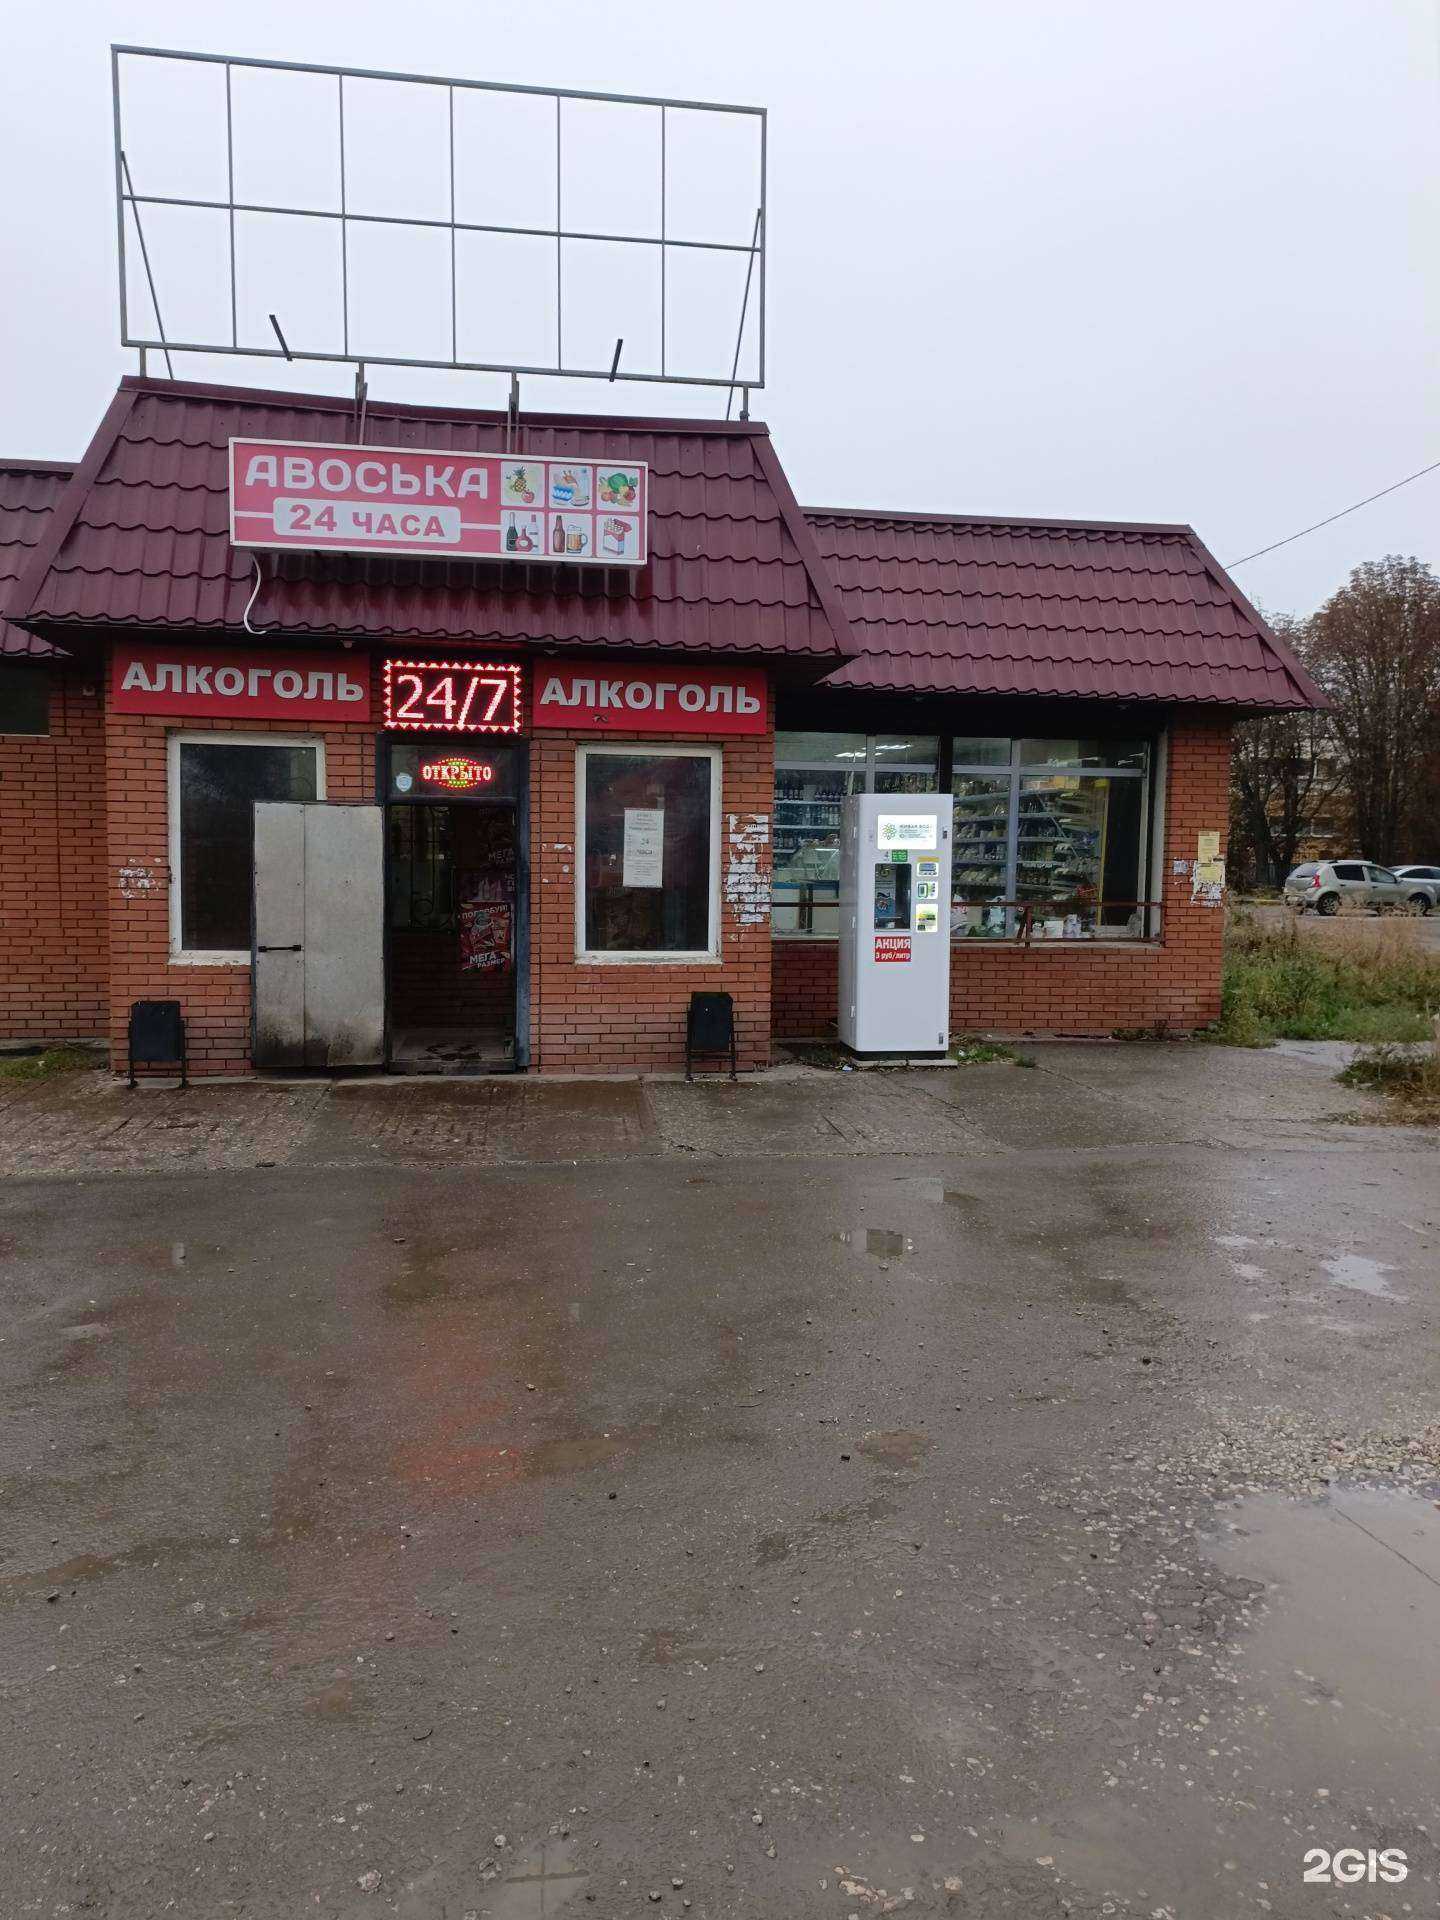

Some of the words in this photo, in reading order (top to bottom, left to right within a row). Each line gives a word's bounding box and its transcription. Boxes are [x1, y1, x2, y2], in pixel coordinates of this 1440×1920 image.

[245, 455, 488, 499] АВОСЬКА
[290, 504, 336, 532] 24
[352, 513, 445, 538] ЧАСА
[121, 662, 363, 702] АЛКОГОЛЬ
[539, 677, 761, 714] АЛКОГОЛЬ
[397, 674, 507, 727] 24/7
[422, 765, 492, 781] ОТКРЫТО
[470, 951, 496, 964] МЕГА
[876, 938, 911, 951] АКЦИЯ
